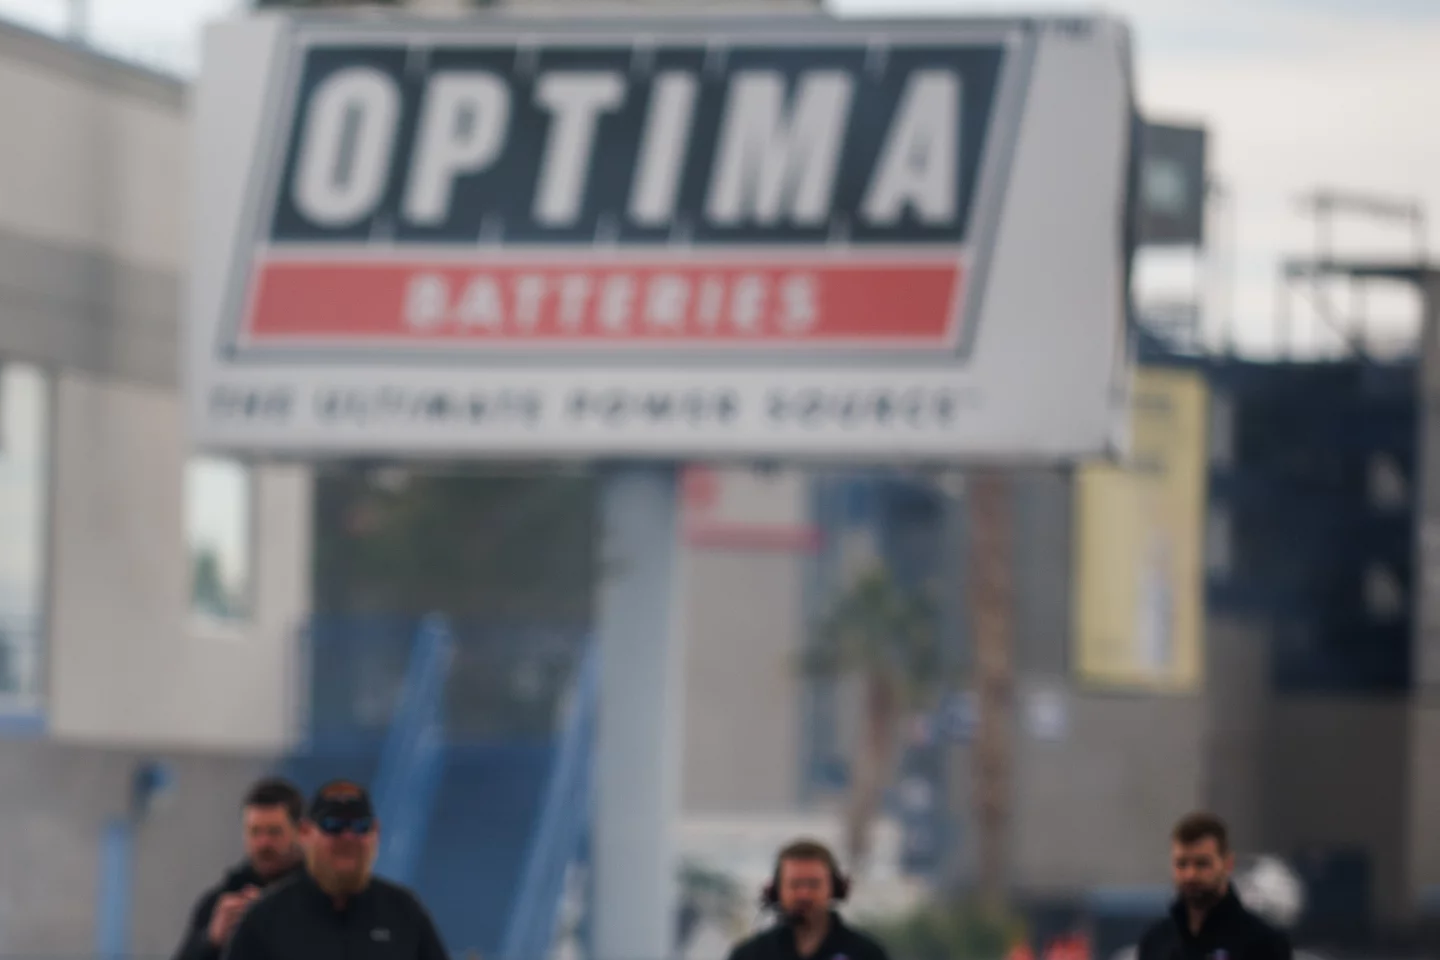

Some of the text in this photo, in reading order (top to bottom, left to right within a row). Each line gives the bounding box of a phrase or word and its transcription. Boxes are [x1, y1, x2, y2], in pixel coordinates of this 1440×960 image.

[292, 65, 962, 227] OPTIMA
[402, 272, 820, 334] BATTERIES
[210, 382, 294, 427] THE
[563, 384, 744, 429] POWER
[763, 384, 962, 431] SOURCE
